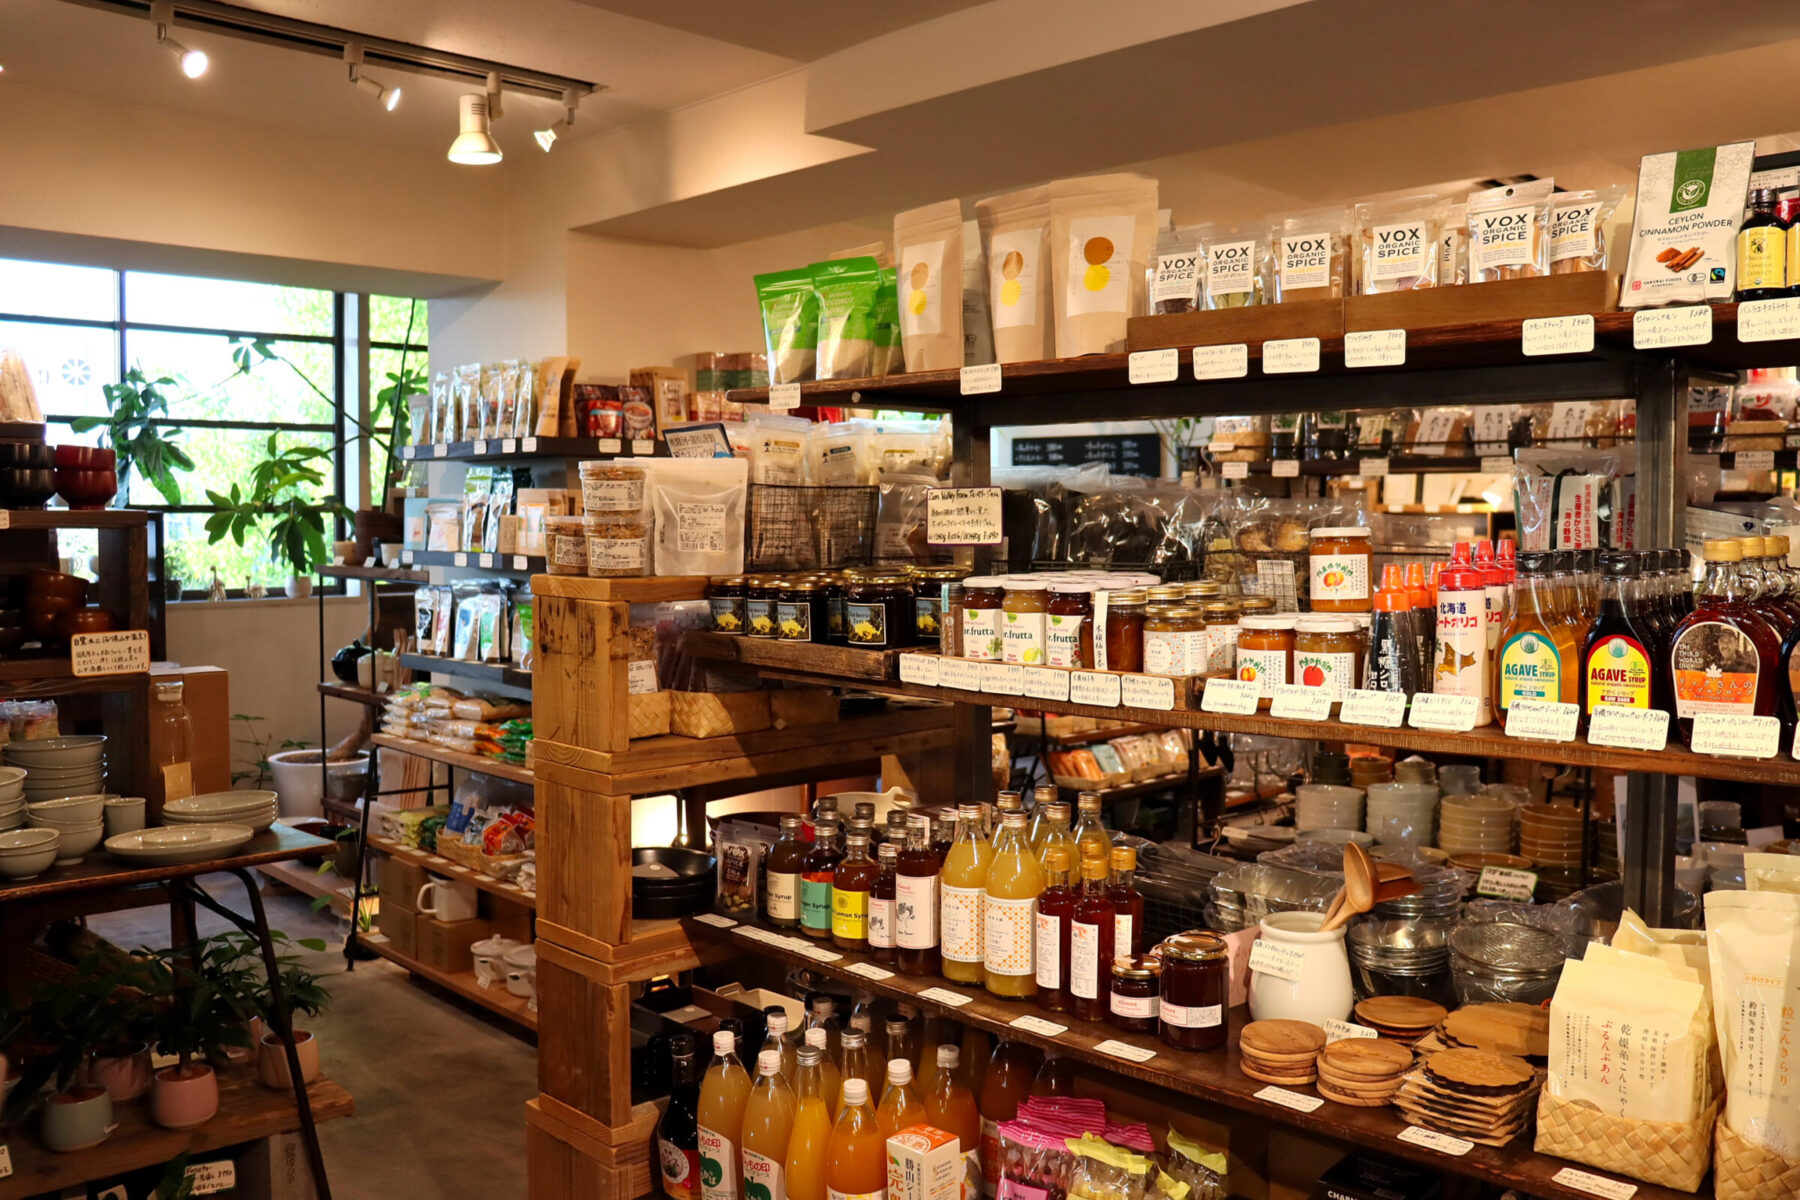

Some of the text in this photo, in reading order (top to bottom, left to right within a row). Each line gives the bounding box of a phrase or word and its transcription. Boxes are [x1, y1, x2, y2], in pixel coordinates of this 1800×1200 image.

[1484, 213, 1529, 229] VOX
[1555, 207, 1595, 222] VOX
[1668, 213, 1704, 225] CEYLON
[1552, 216, 1589, 230] ORGANIC
[1640, 224, 1690, 238] CINNAMON
[1691, 219, 1733, 230] POWDER
[1379, 228, 1420, 243] VOX
[1482, 224, 1527, 236] ORGANIC
[1551, 222, 1589, 239] SPICE
[1482, 231, 1527, 245] SPICE
[1287, 239, 1326, 254] VOX
[1378, 240, 1421, 250] ORGANIC
[1214, 246, 1250, 260] VOX
[1287, 251, 1326, 260] ORGANIC
[1377, 246, 1420, 258] SPICE
[1162, 257, 1197, 270] VOX
[1212, 257, 1249, 266] ORGANIC
[1286, 257, 1326, 268] SPICE
[1212, 263, 1249, 275] SPICE
[1159, 271, 1194, 282] SPICE
[1440, 602, 1467, 615] 北海道
[1378, 639, 1392, 691] 黒糖シロ
[1505, 664, 1538, 677] AGAVE
[1591, 668, 1627, 682] AGAVE
[1680, 677, 1753, 689] リックさんの
